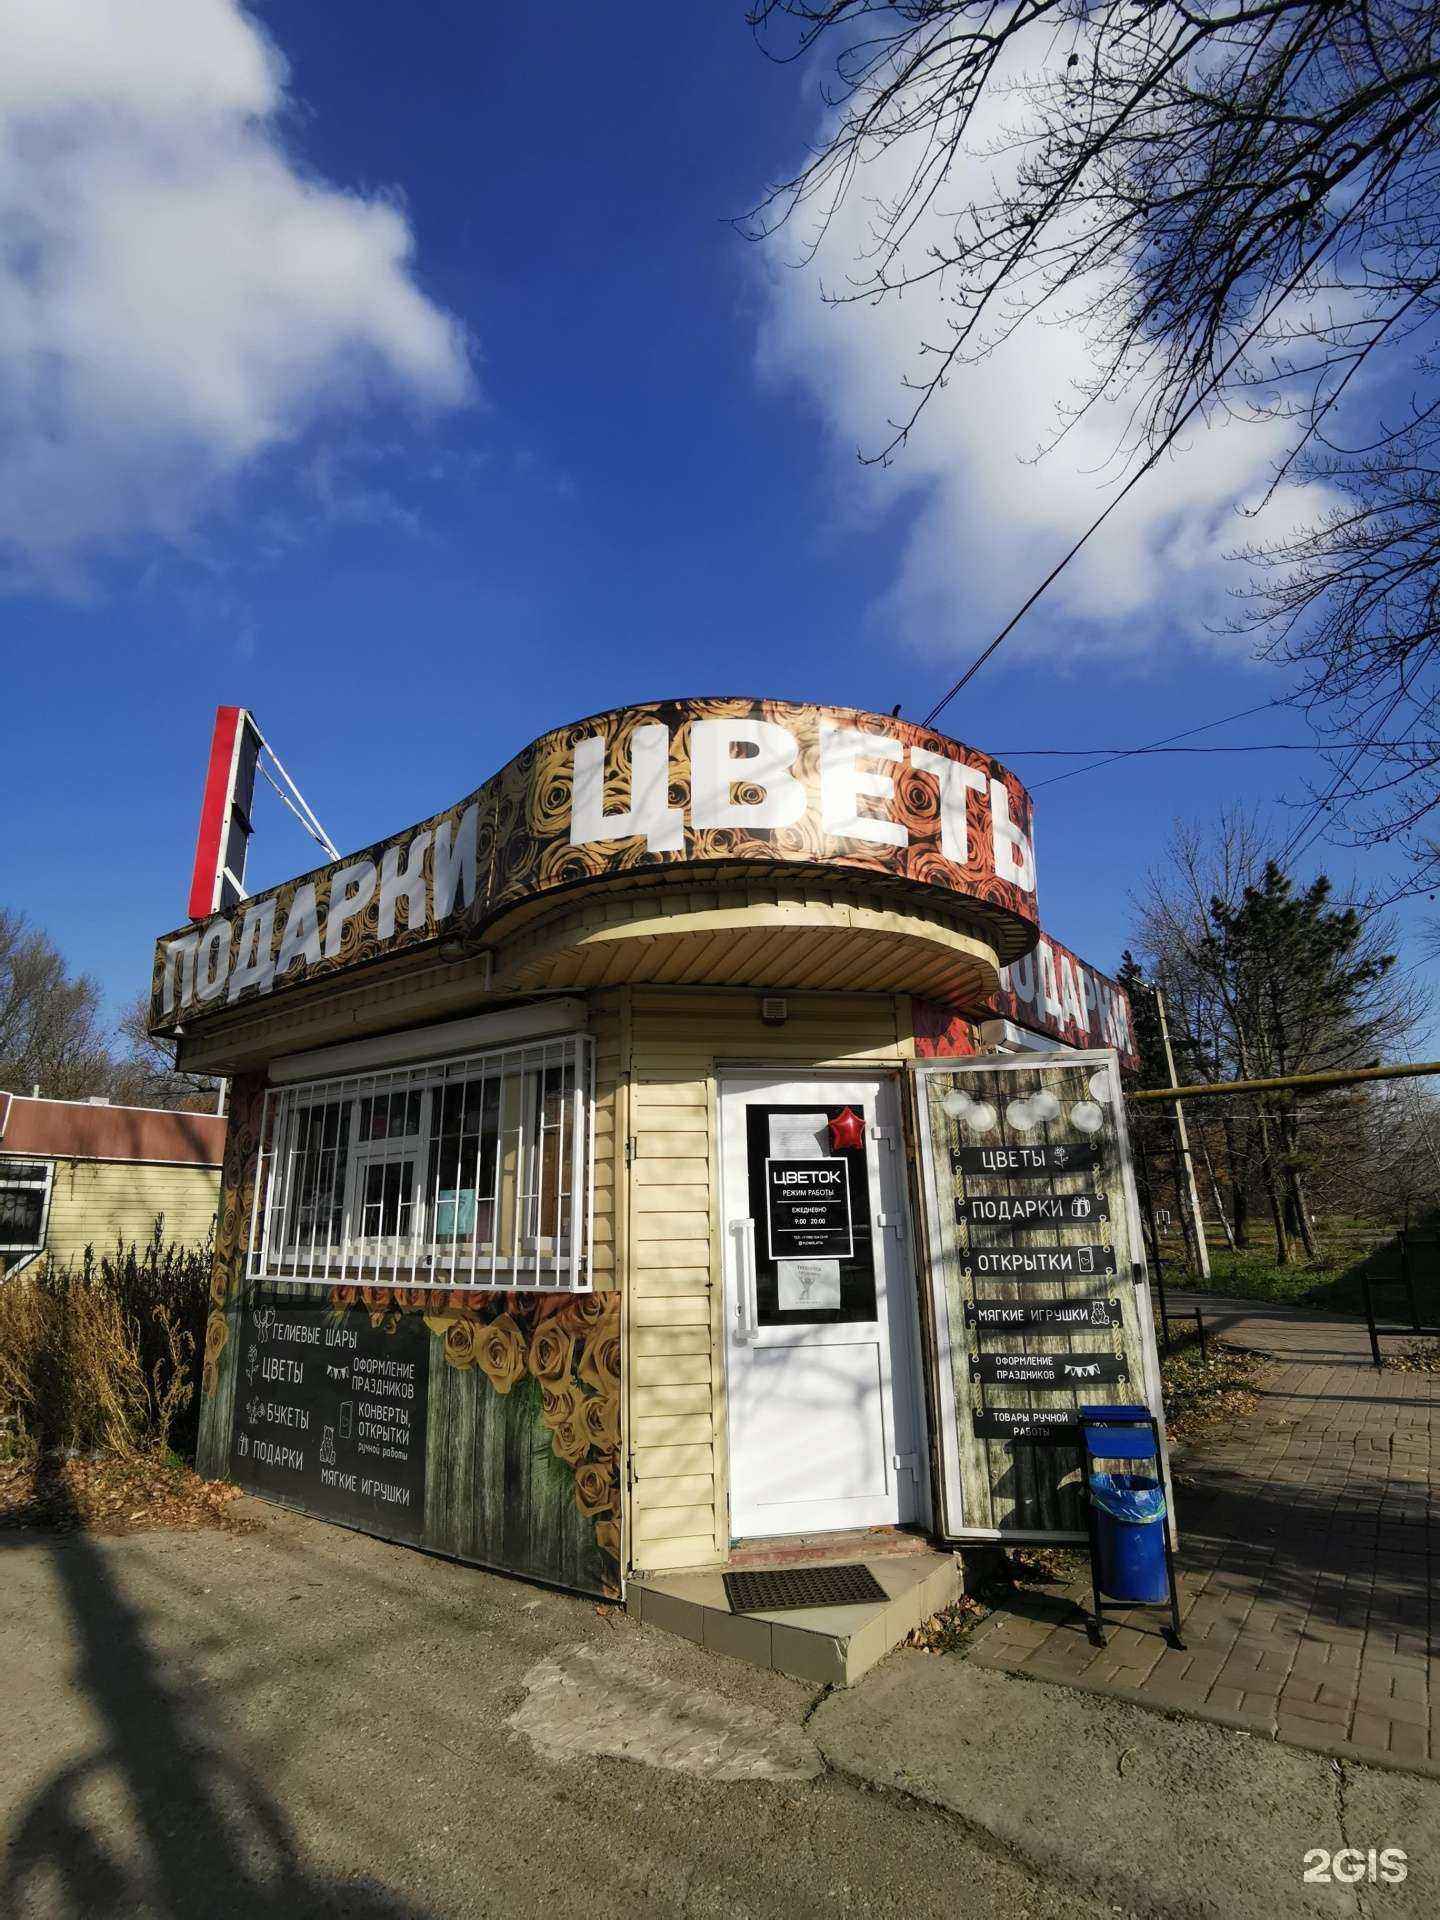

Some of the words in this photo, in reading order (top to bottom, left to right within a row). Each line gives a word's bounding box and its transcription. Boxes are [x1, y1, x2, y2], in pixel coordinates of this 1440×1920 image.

[162, 803, 479, 1014] ПОДАРКИ
[999, 939, 1132, 1055] ОДАРКИ
[981, 1149, 1046, 1170] ЦВЕТЫ
[773, 1170, 841, 1185] ЦВЕТОК
[782, 1189, 807, 1197] РЕЖИМ
[808, 1188, 834, 1196] РАБОТЫ
[972, 1200, 1064, 1220] ПОДАРКИ
[978, 1253, 1073, 1272] ОТКРЫТКИ
[978, 1308, 1025, 1322] МЯГКИЕ
[1030, 1308, 1089, 1322] ИГРУШКИ
[272, 1322, 321, 1345] ГЕЛИЕВЫЕ
[325, 1327, 357, 1348] ШАРЫ
[262, 1357, 304, 1384] ЦВЕТЫ
[353, 1357, 415, 1380] ОФОРМЛЕНИЕ
[995, 1357, 1054, 1367] ОФОРМЛЕНИЕ
[996, 1371, 1055, 1381] ПРАЗДНИКОВ
[351, 1376, 415, 1399] ПРАЗДНИКОВ
[267, 1403, 310, 1430] БУКЕТЫ
[358, 1402, 411, 1428] КОНВЕРТЫ,
[993, 1412, 1030, 1422] ТОВАРЫ
[1033, 1411, 1069, 1423] РУЧНОЙ
[358, 1421, 410, 1446] ОТКРЫТКИ
[1013, 1426, 1050, 1437] РАБОТЫ
[252, 1440, 304, 1471] ПОДАРКИ
[358, 1442, 380, 1455] ручной
[320, 1468, 357, 1492] МЯГКИЕ
[361, 1478, 410, 1506] ИГРУШКИ
